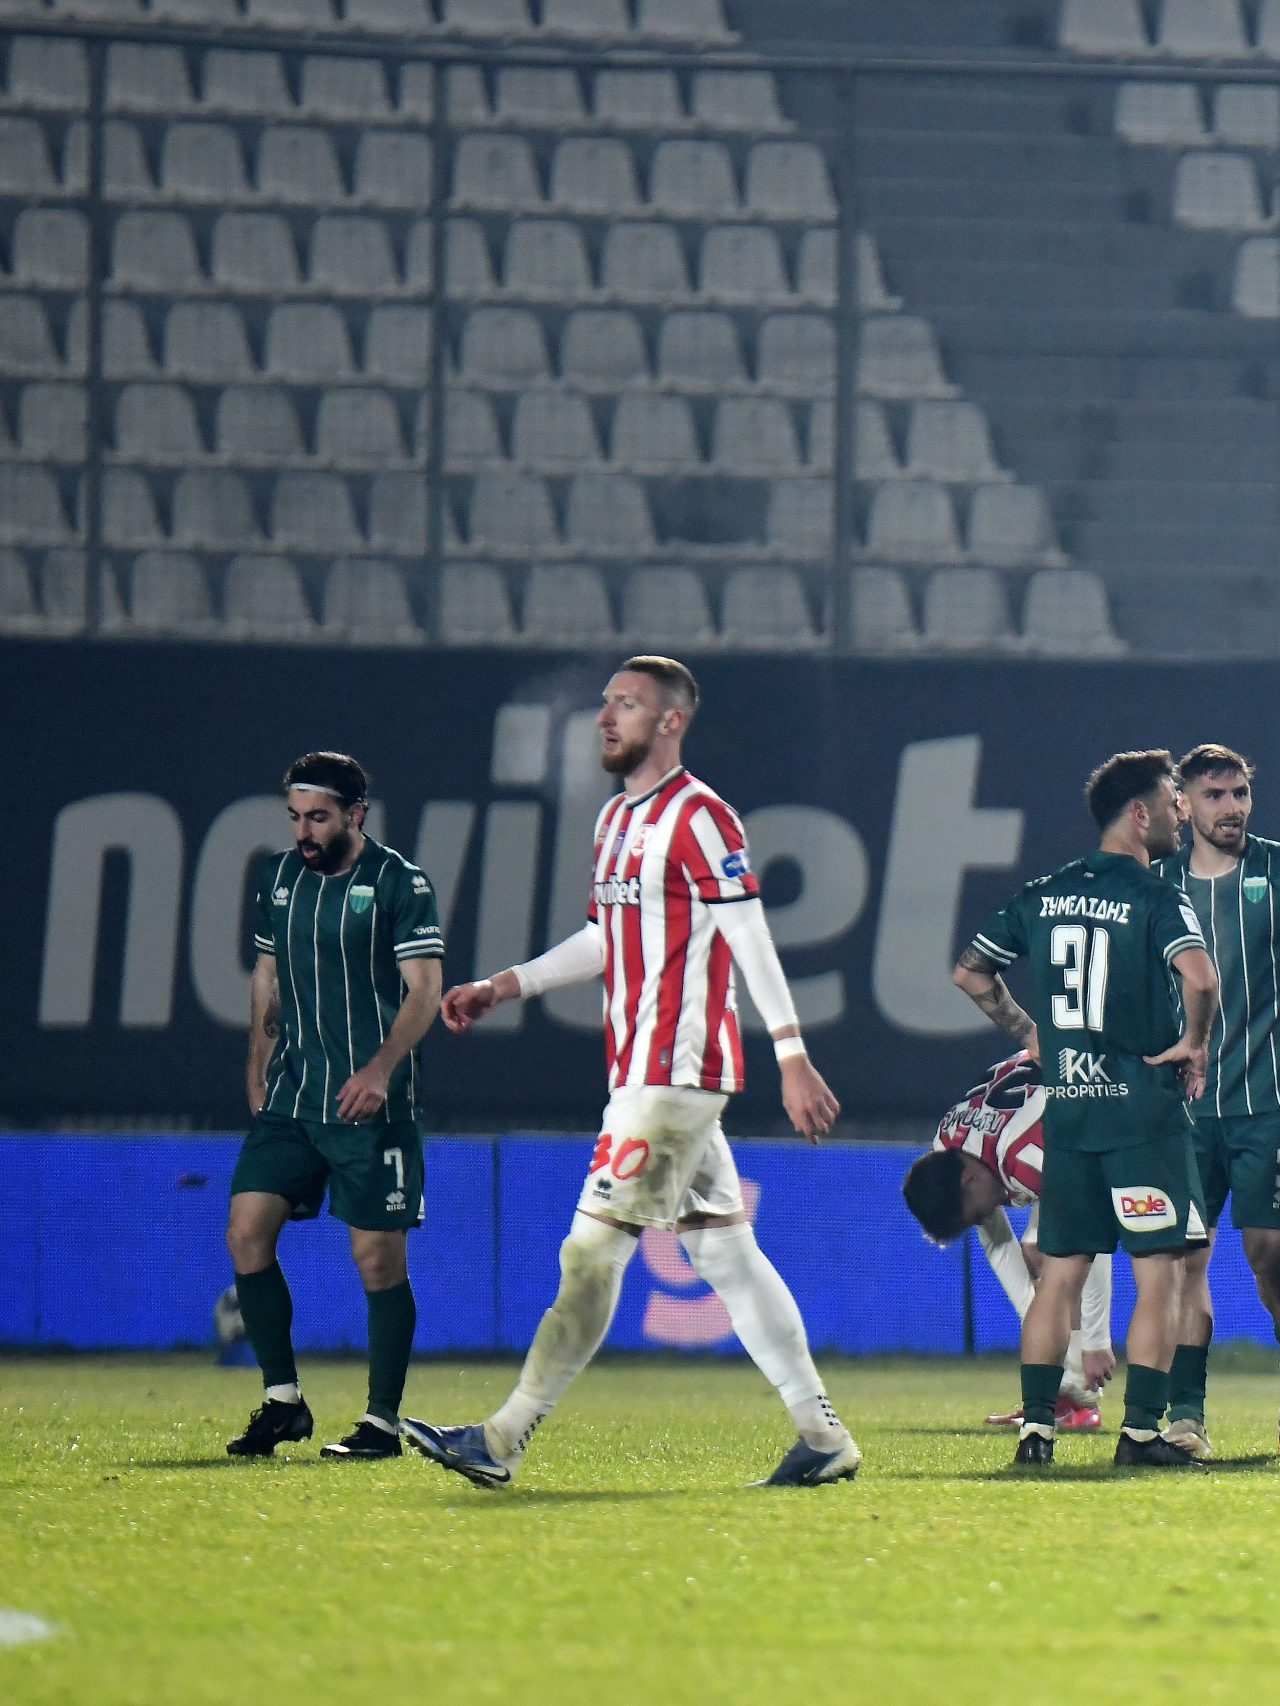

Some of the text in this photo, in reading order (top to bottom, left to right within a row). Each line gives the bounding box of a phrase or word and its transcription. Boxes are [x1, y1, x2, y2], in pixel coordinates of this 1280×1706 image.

[1039, 895, 1131, 924] ΣΥΜΕΛΙΔΗΣ
[1050, 924, 1109, 1032] 31
[383, 1147, 405, 1189] 7
[1121, 1194, 1167, 1214] Dole
